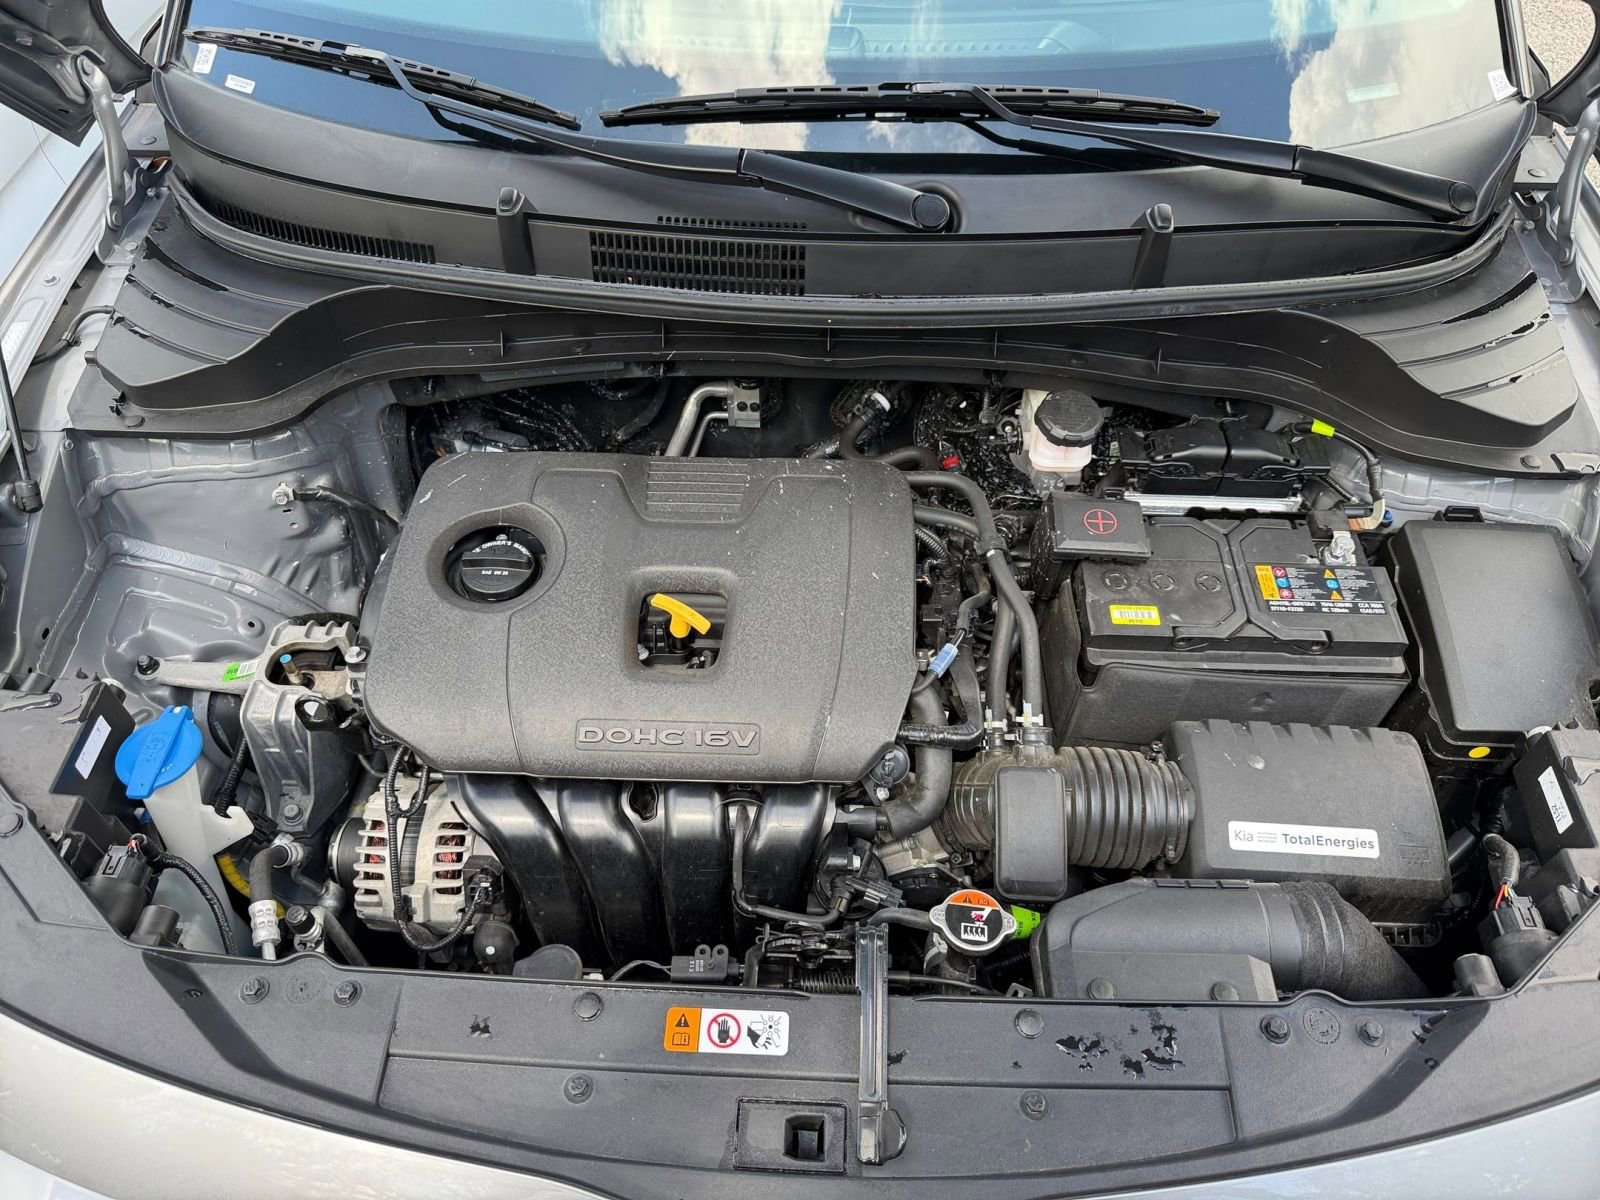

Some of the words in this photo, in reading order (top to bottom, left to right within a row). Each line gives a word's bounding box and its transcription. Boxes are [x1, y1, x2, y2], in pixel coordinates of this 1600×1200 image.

[578, 726, 685, 746] DOHC
[694, 729, 758, 748] 16V
[1234, 830, 1254, 842] Kia
[1281, 833, 1375, 850] TotalEnergies
